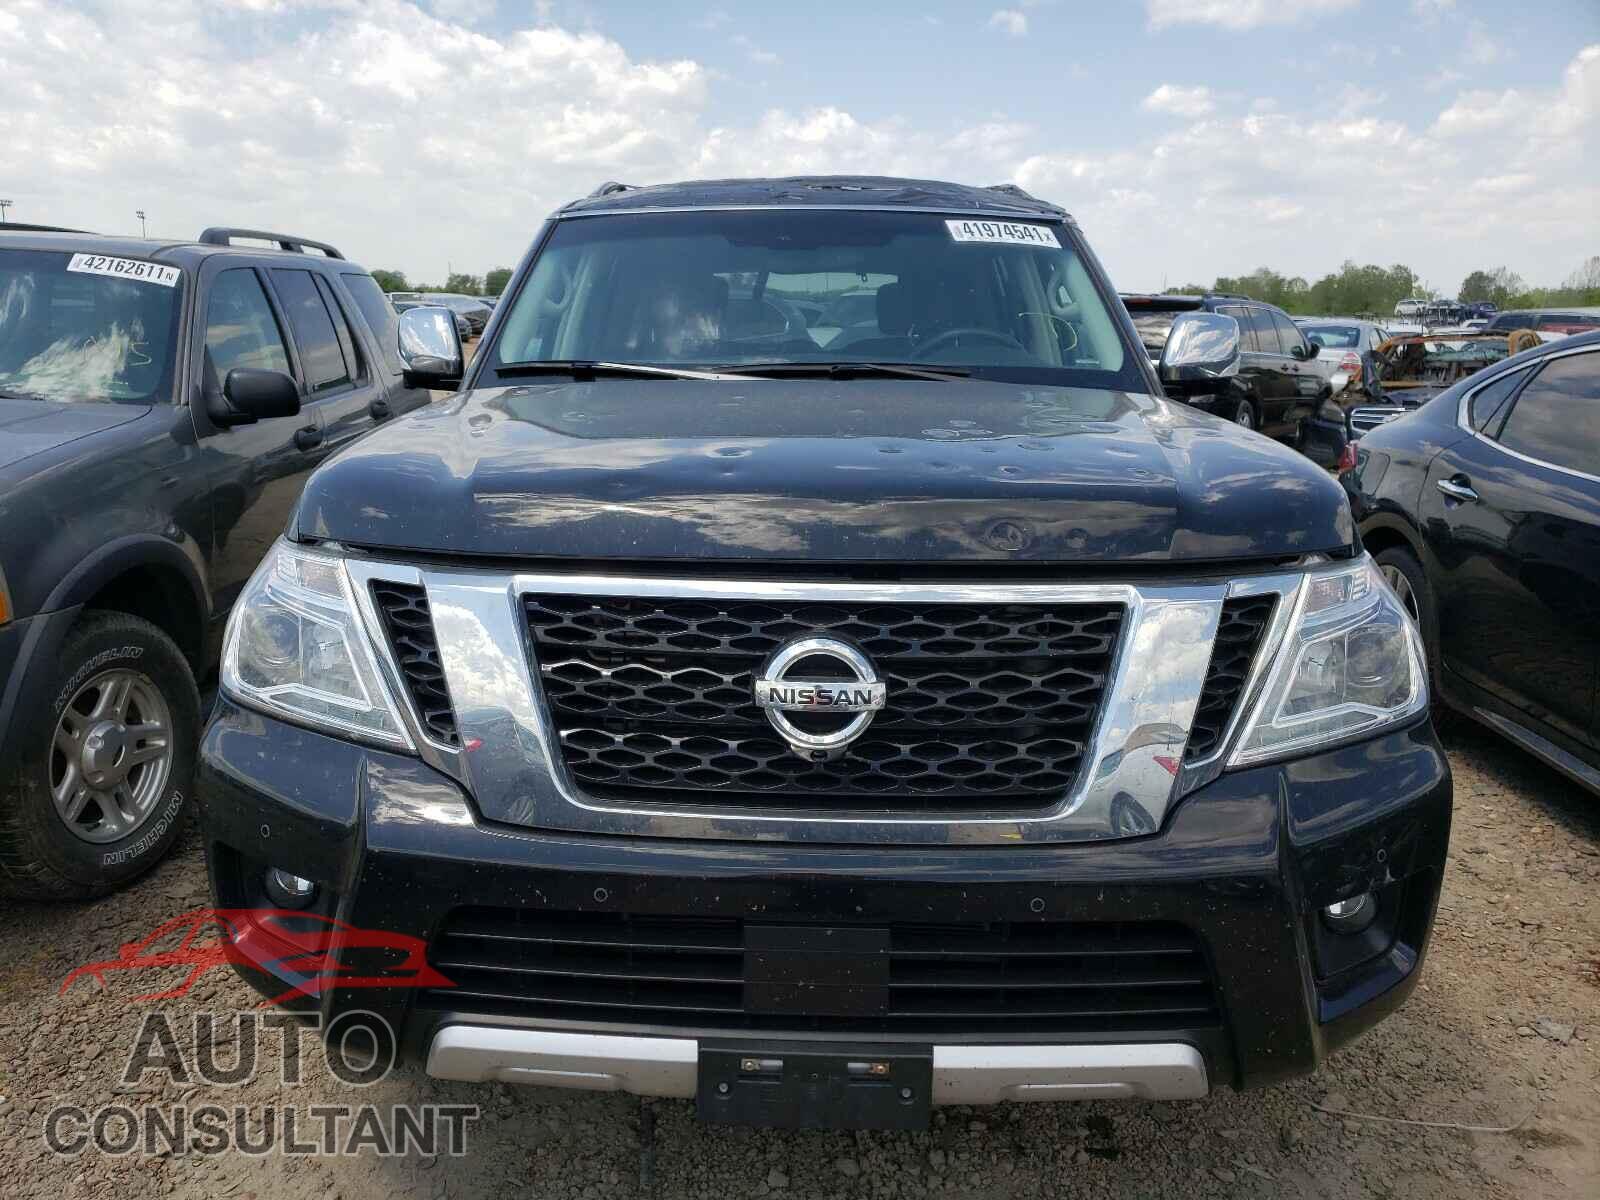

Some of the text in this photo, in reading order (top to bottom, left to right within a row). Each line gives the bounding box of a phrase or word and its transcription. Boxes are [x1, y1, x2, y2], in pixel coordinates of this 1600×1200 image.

[963, 222, 1044, 242] 41974541
[84, 256, 165, 280] 42162611
[769, 687, 872, 706] NISSAN
[103, 790, 184, 866] MICHELIN
